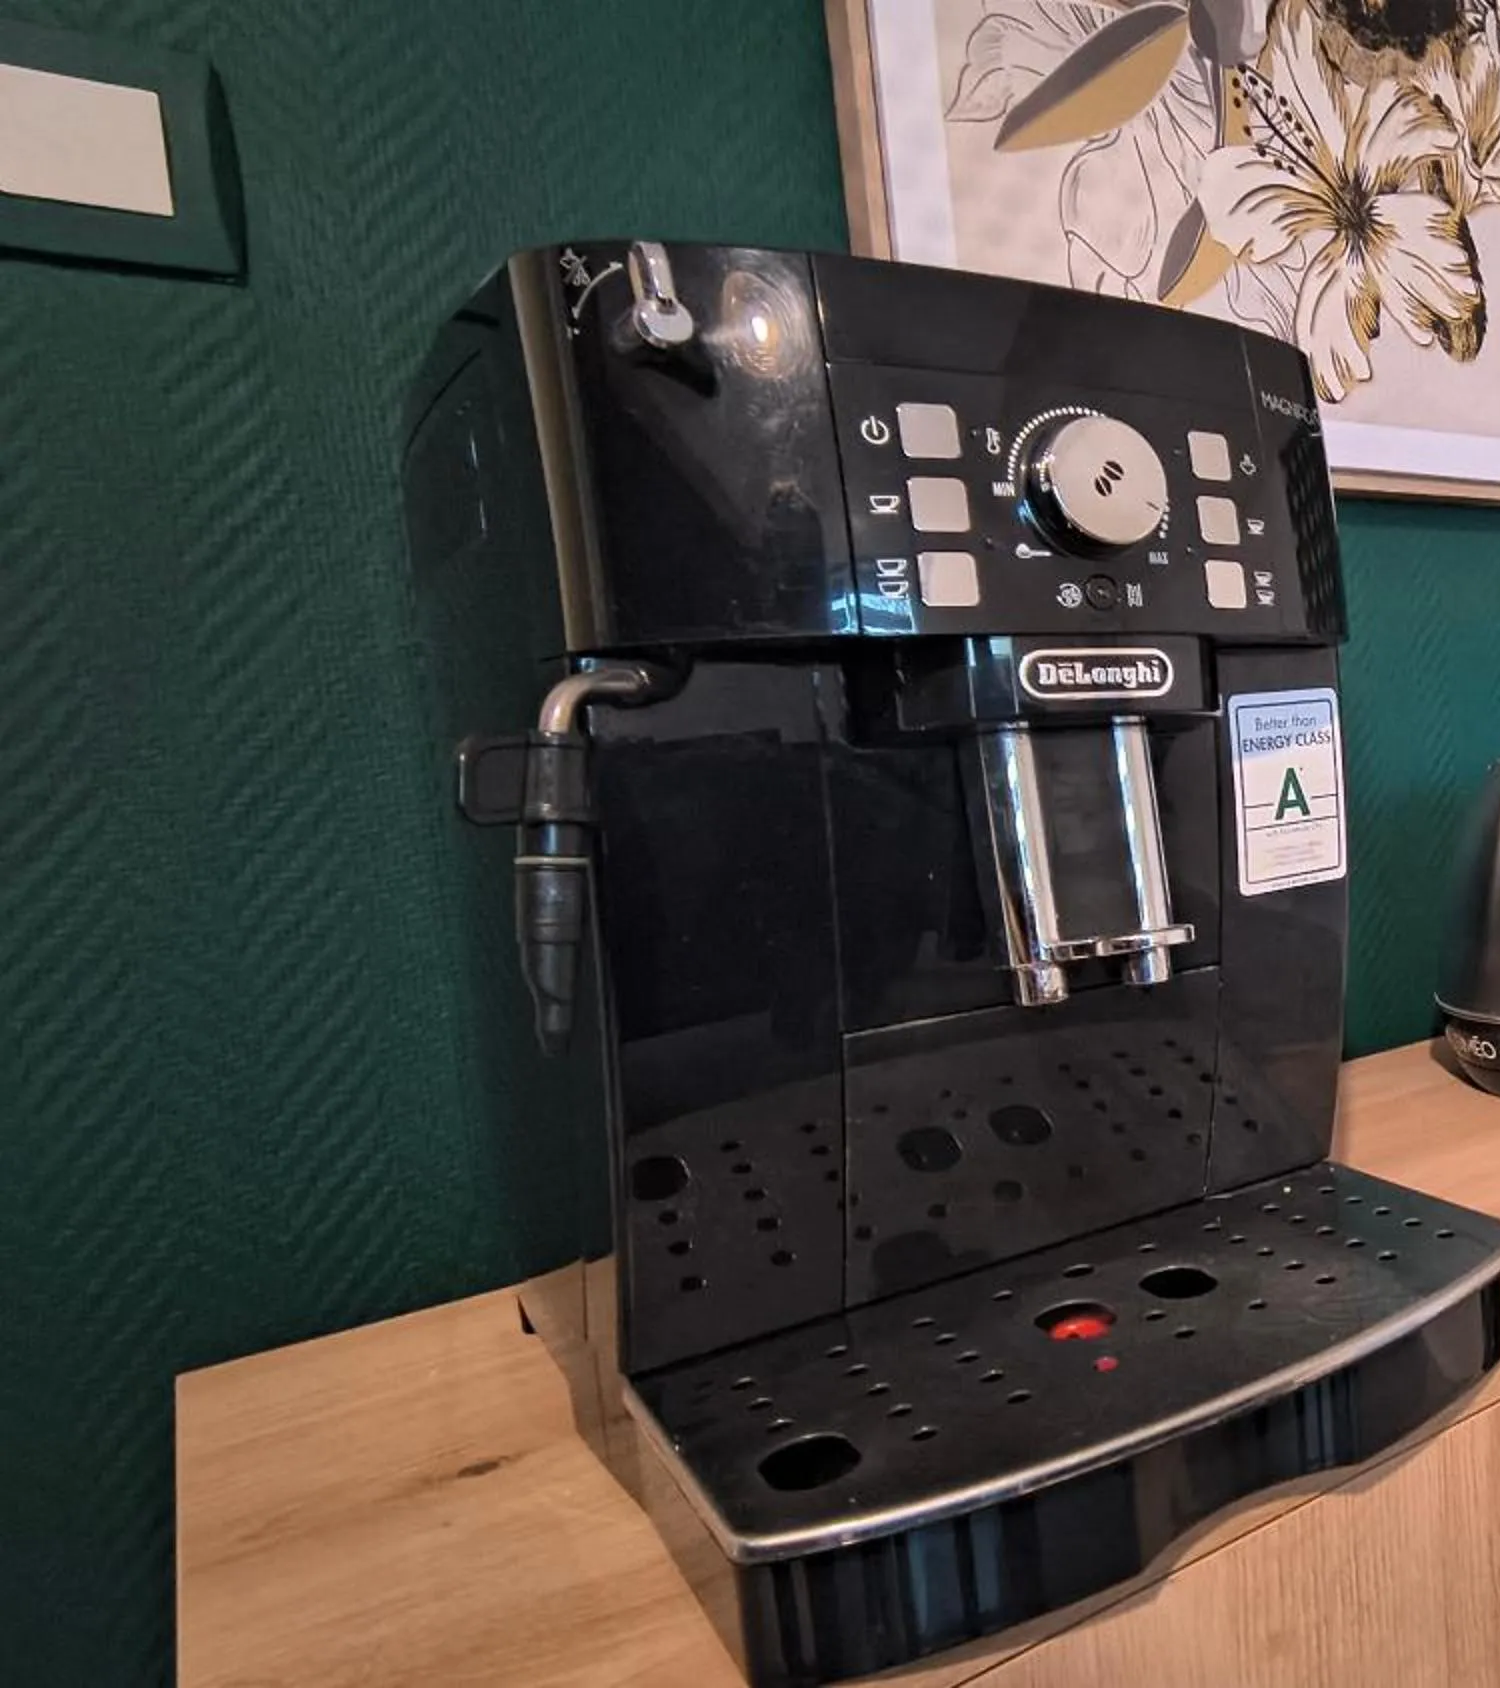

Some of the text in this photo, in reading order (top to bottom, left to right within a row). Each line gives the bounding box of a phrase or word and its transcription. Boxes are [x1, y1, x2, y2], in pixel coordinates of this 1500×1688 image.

[992, 481, 1016, 497] MIN
[1254, 715, 1317, 731] Better than
[1242, 730, 1331, 753] ENERGY CLASS
[1274, 767, 1311, 820] A
